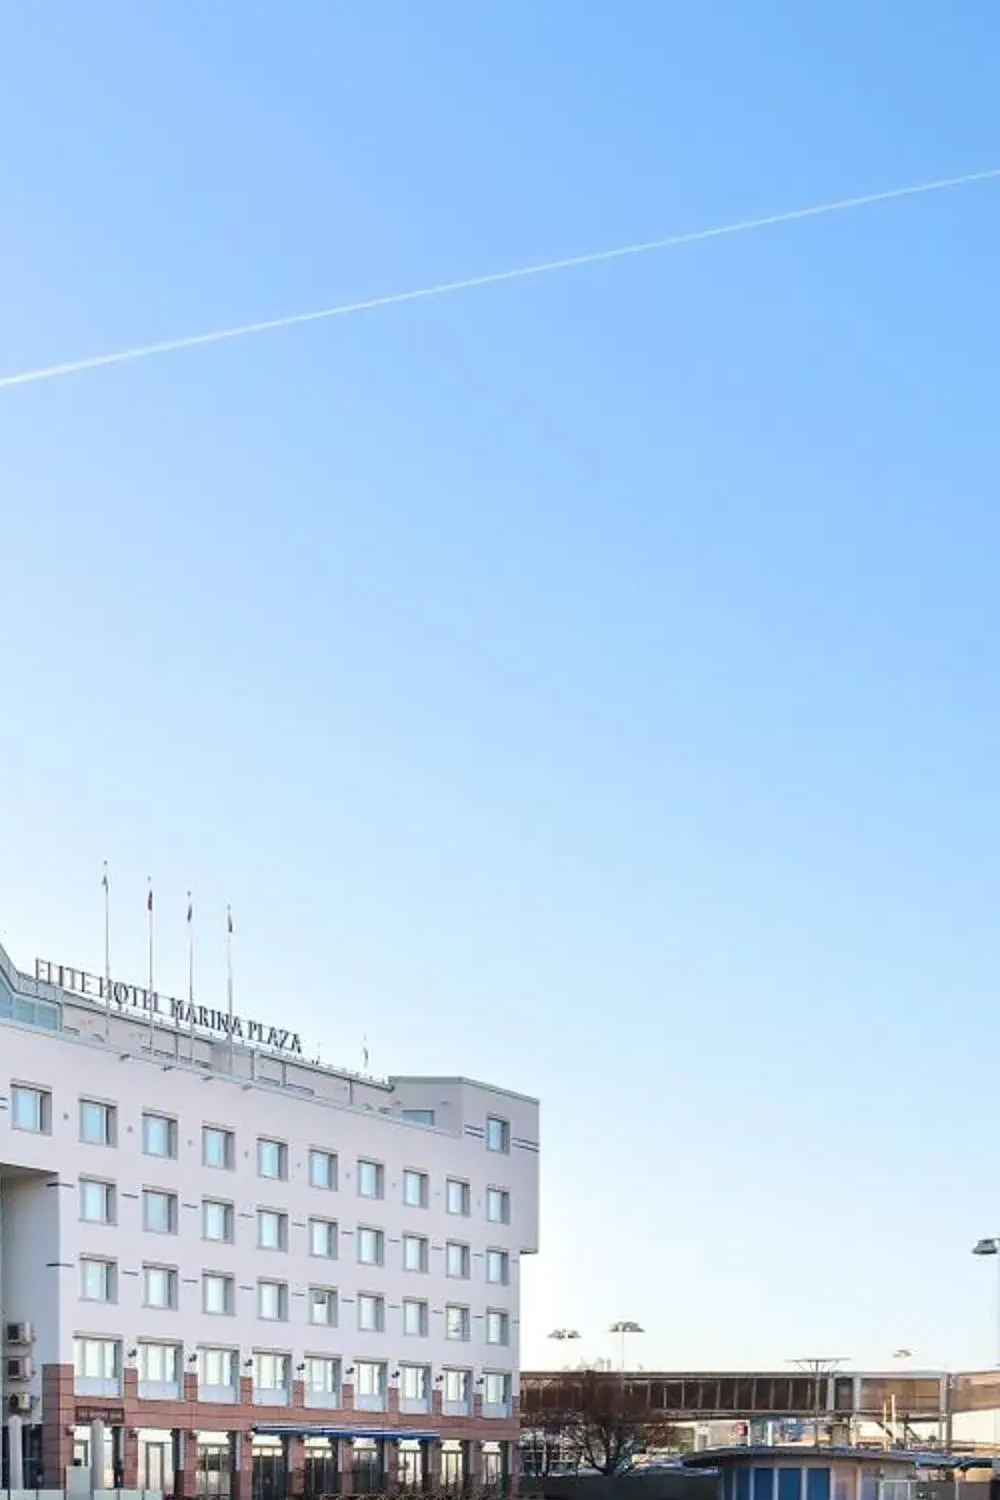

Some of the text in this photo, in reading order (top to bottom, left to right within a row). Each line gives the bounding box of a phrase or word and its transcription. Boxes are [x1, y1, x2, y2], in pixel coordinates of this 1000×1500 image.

[35, 957, 302, 1053] ELITE HOTEL MARINA PLAZA
